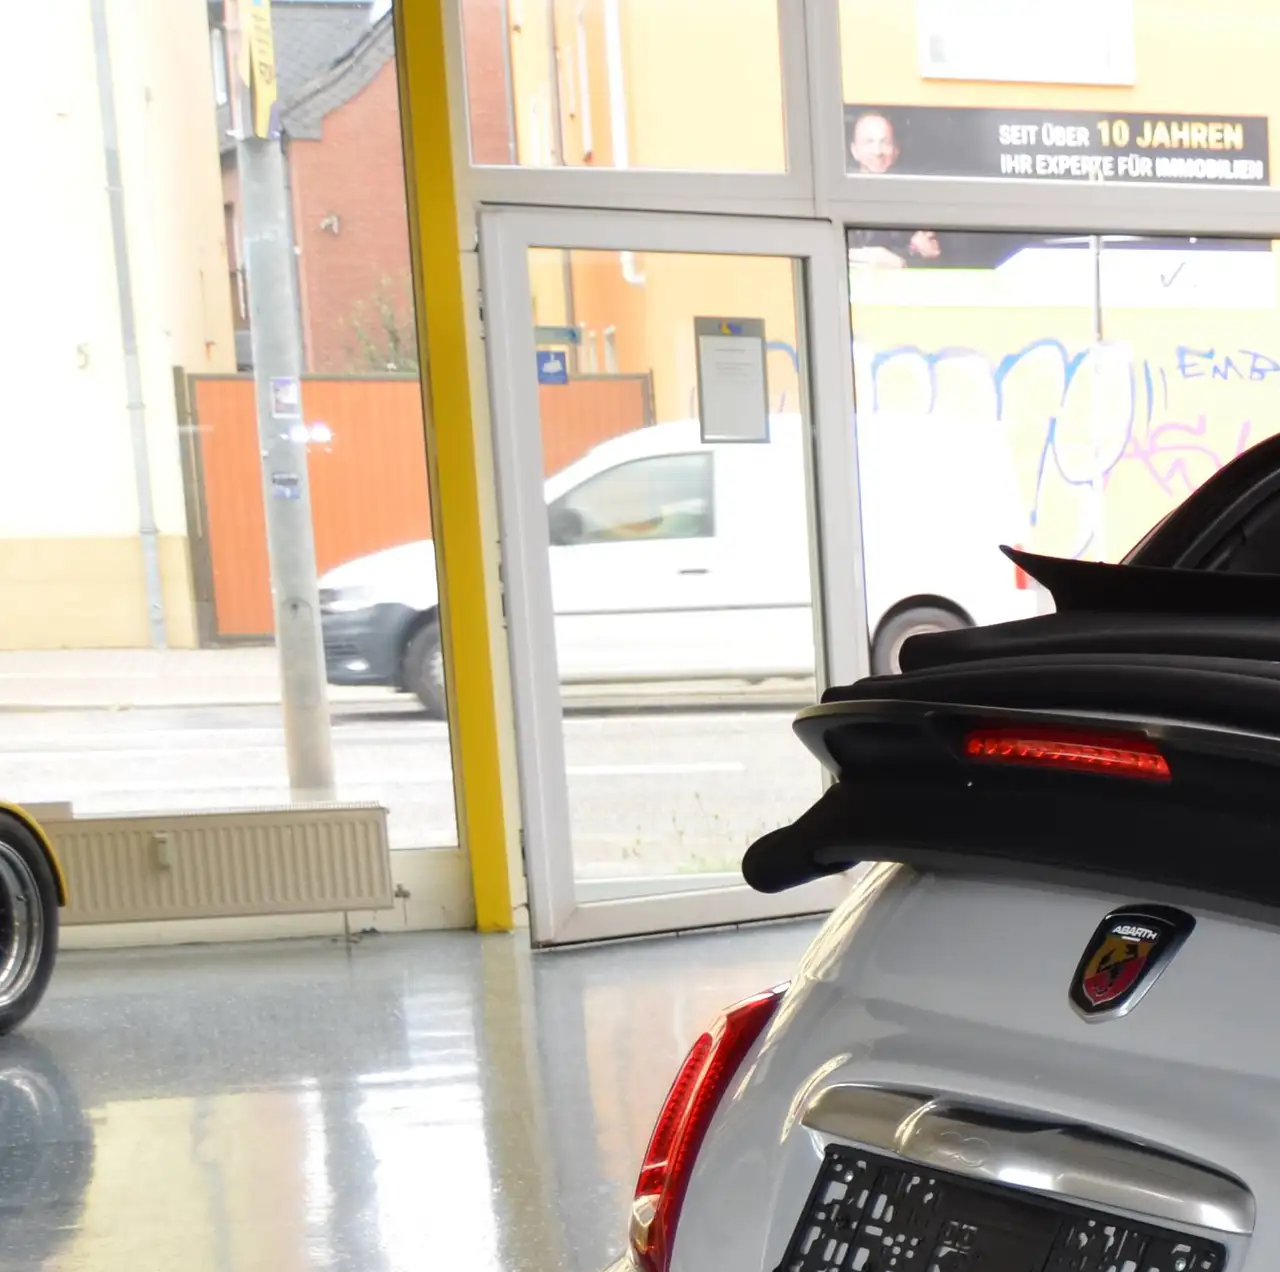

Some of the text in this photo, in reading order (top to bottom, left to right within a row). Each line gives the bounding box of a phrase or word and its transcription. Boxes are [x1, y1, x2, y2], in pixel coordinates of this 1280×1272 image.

[999, 120, 1244, 150] SEIT ÜBER 10 JAHREN
[1000, 154, 1032, 174] IHR
[1117, 153, 1153, 177] FÜR
[1112, 925, 1158, 940] ABARTH
